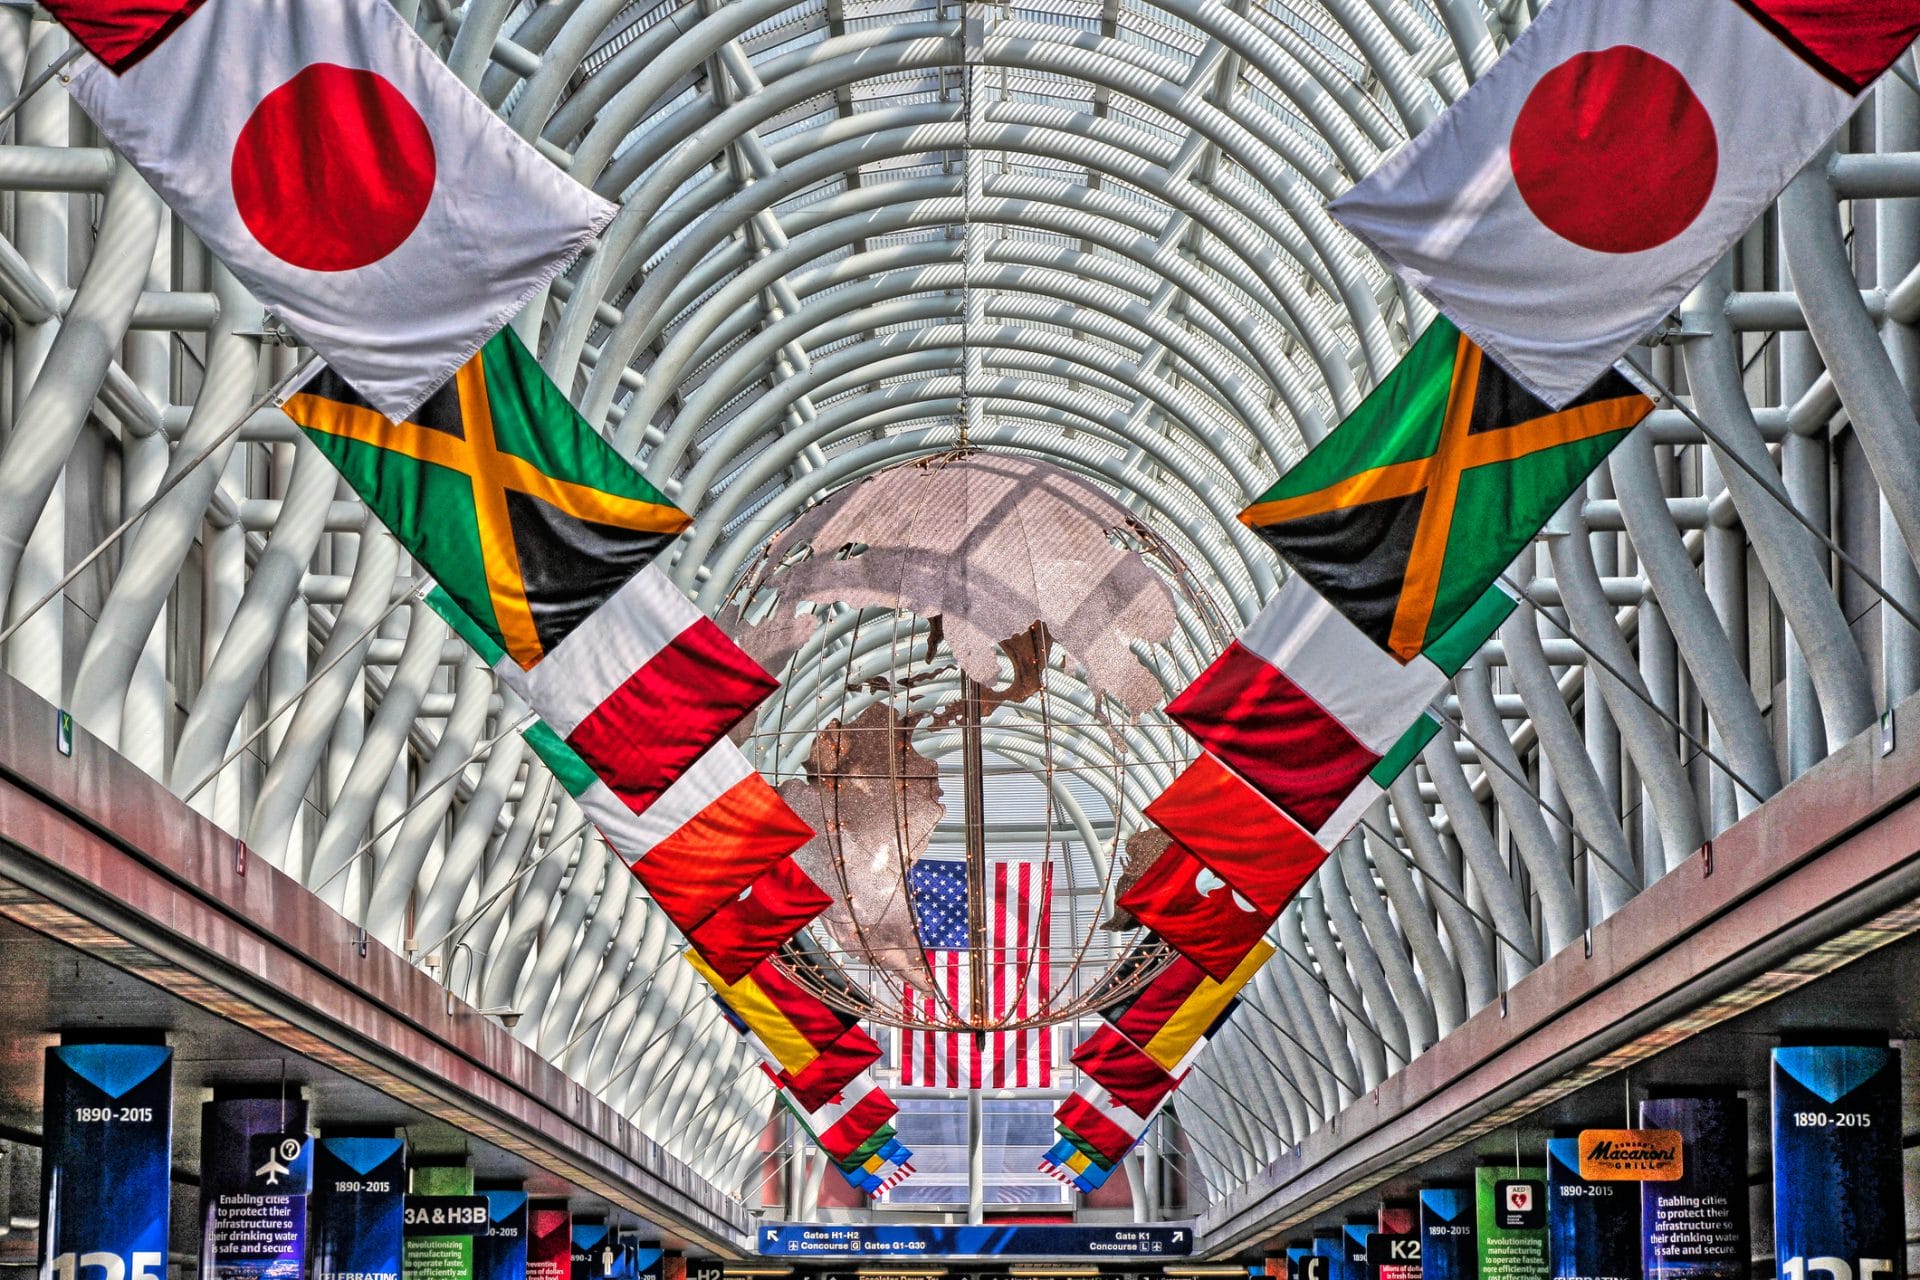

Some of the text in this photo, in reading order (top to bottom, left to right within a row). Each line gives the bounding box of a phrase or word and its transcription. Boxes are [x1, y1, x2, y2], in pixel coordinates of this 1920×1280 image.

[75, 1107, 153, 1122] 1890-2015
[1793, 1112, 1871, 1127] 1890-2015
[1587, 1141, 1675, 1160] Macaroni
[335, 1181, 390, 1193] 1890-2015
[1560, 1185, 1613, 1197] 1890-2015
[220, 1194, 263, 1206] Enabling
[1658, 1195, 1700, 1208] Enabling
[218, 1206, 291, 1218] to protect their
[432, 1208, 446, 1224] &
[447, 1207, 487, 1224] H3B
[1657, 1208, 1730, 1221] to protect their
[215, 1219, 282, 1229] infrastructure
[1655, 1221, 1721, 1231] infrastructure
[229, 1230, 273, 1242] drinking
[274, 1232, 298, 1240] water
[803, 1231, 860, 1239] Gates H1-H2
[1115, 1231, 1150, 1240] Gate K1
[1429, 1226, 1471, 1235] 1890-2015
[1650, 1233, 1669, 1244] their
[1670, 1232, 1713, 1244] drinking
[219, 1243, 239, 1253] safe
[240, 1243, 261, 1253] and
[800, 1241, 849, 1249] Concourse
[864, 1241, 891, 1250] Gates
[892, 1241, 926, 1250] G1-G30
[1089, 1242, 1138, 1250] Concourse
[1391, 1240, 1421, 1259] K2
[1661, 1245, 1680, 1255] safe
[1682, 1245, 1702, 1255] and
